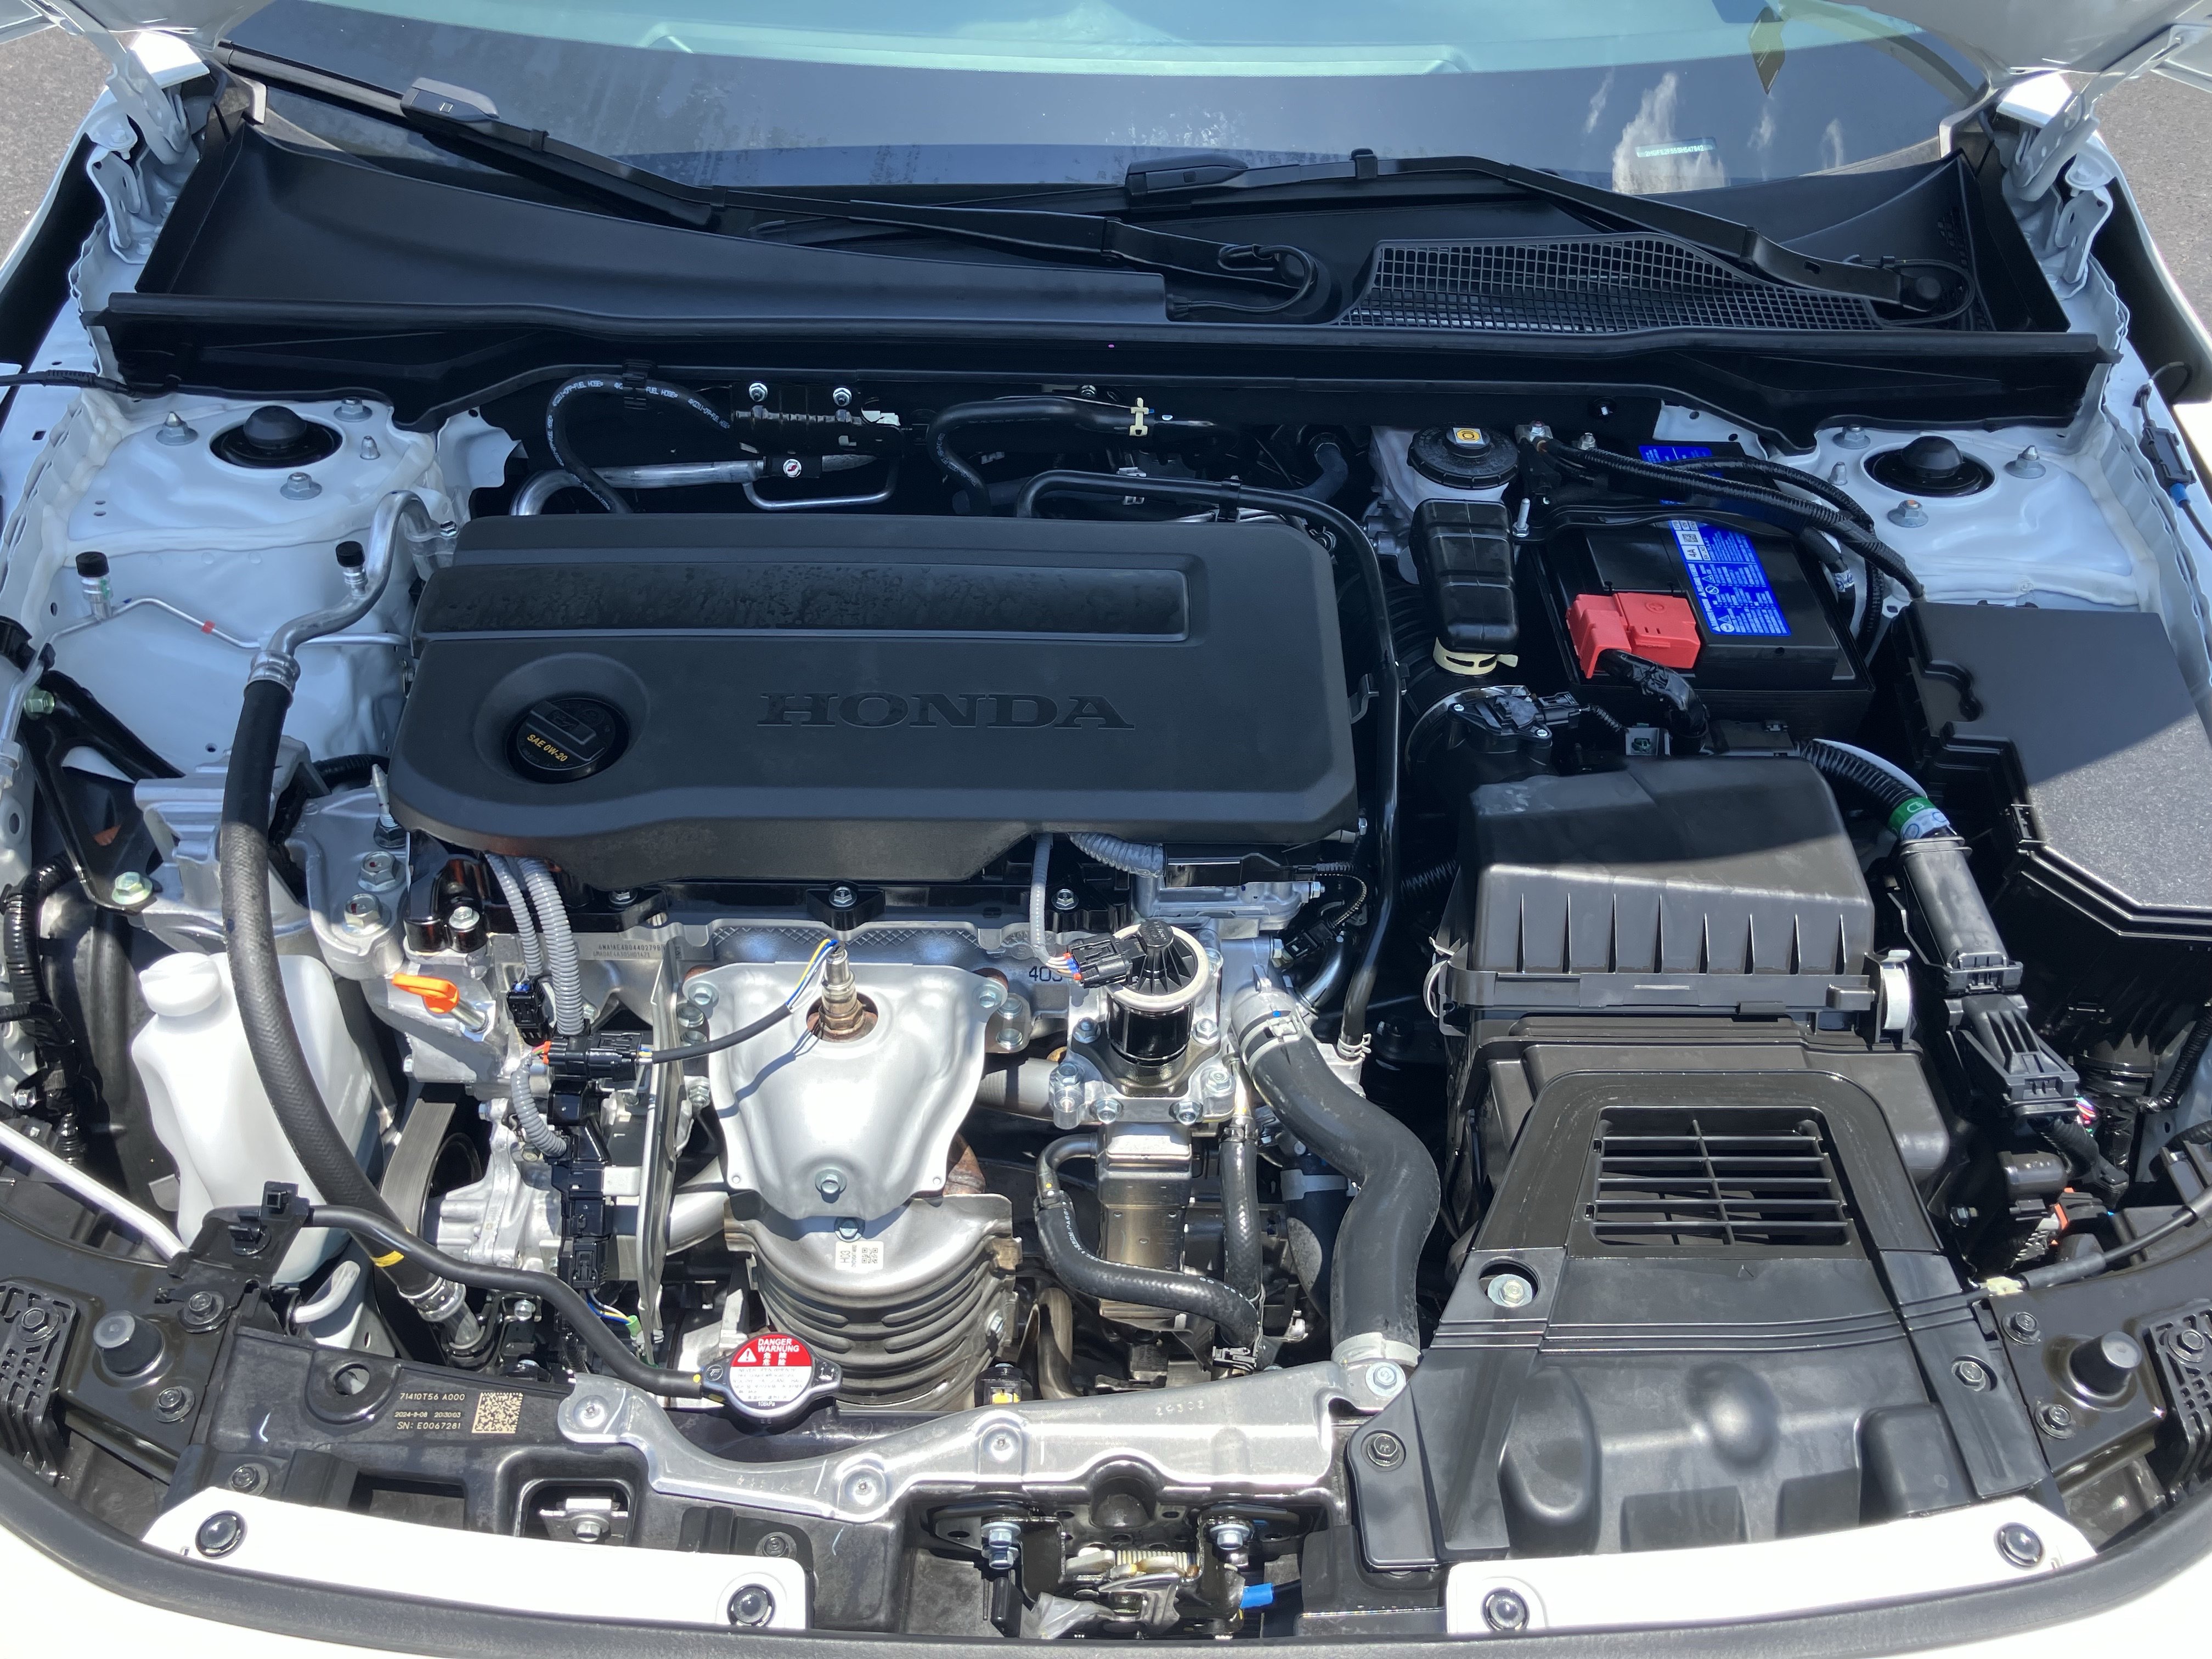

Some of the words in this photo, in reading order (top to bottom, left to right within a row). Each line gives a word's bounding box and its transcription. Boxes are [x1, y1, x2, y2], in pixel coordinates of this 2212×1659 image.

[757, 692, 1135, 730] HONDA
[527, 733, 546, 748] SAE
[543, 744, 568, 762] 0W-20
[400, 1392, 439, 1401] 71410T56
[397, 1421, 414, 1430] SN:
[416, 1421, 461, 1430] E0067281
